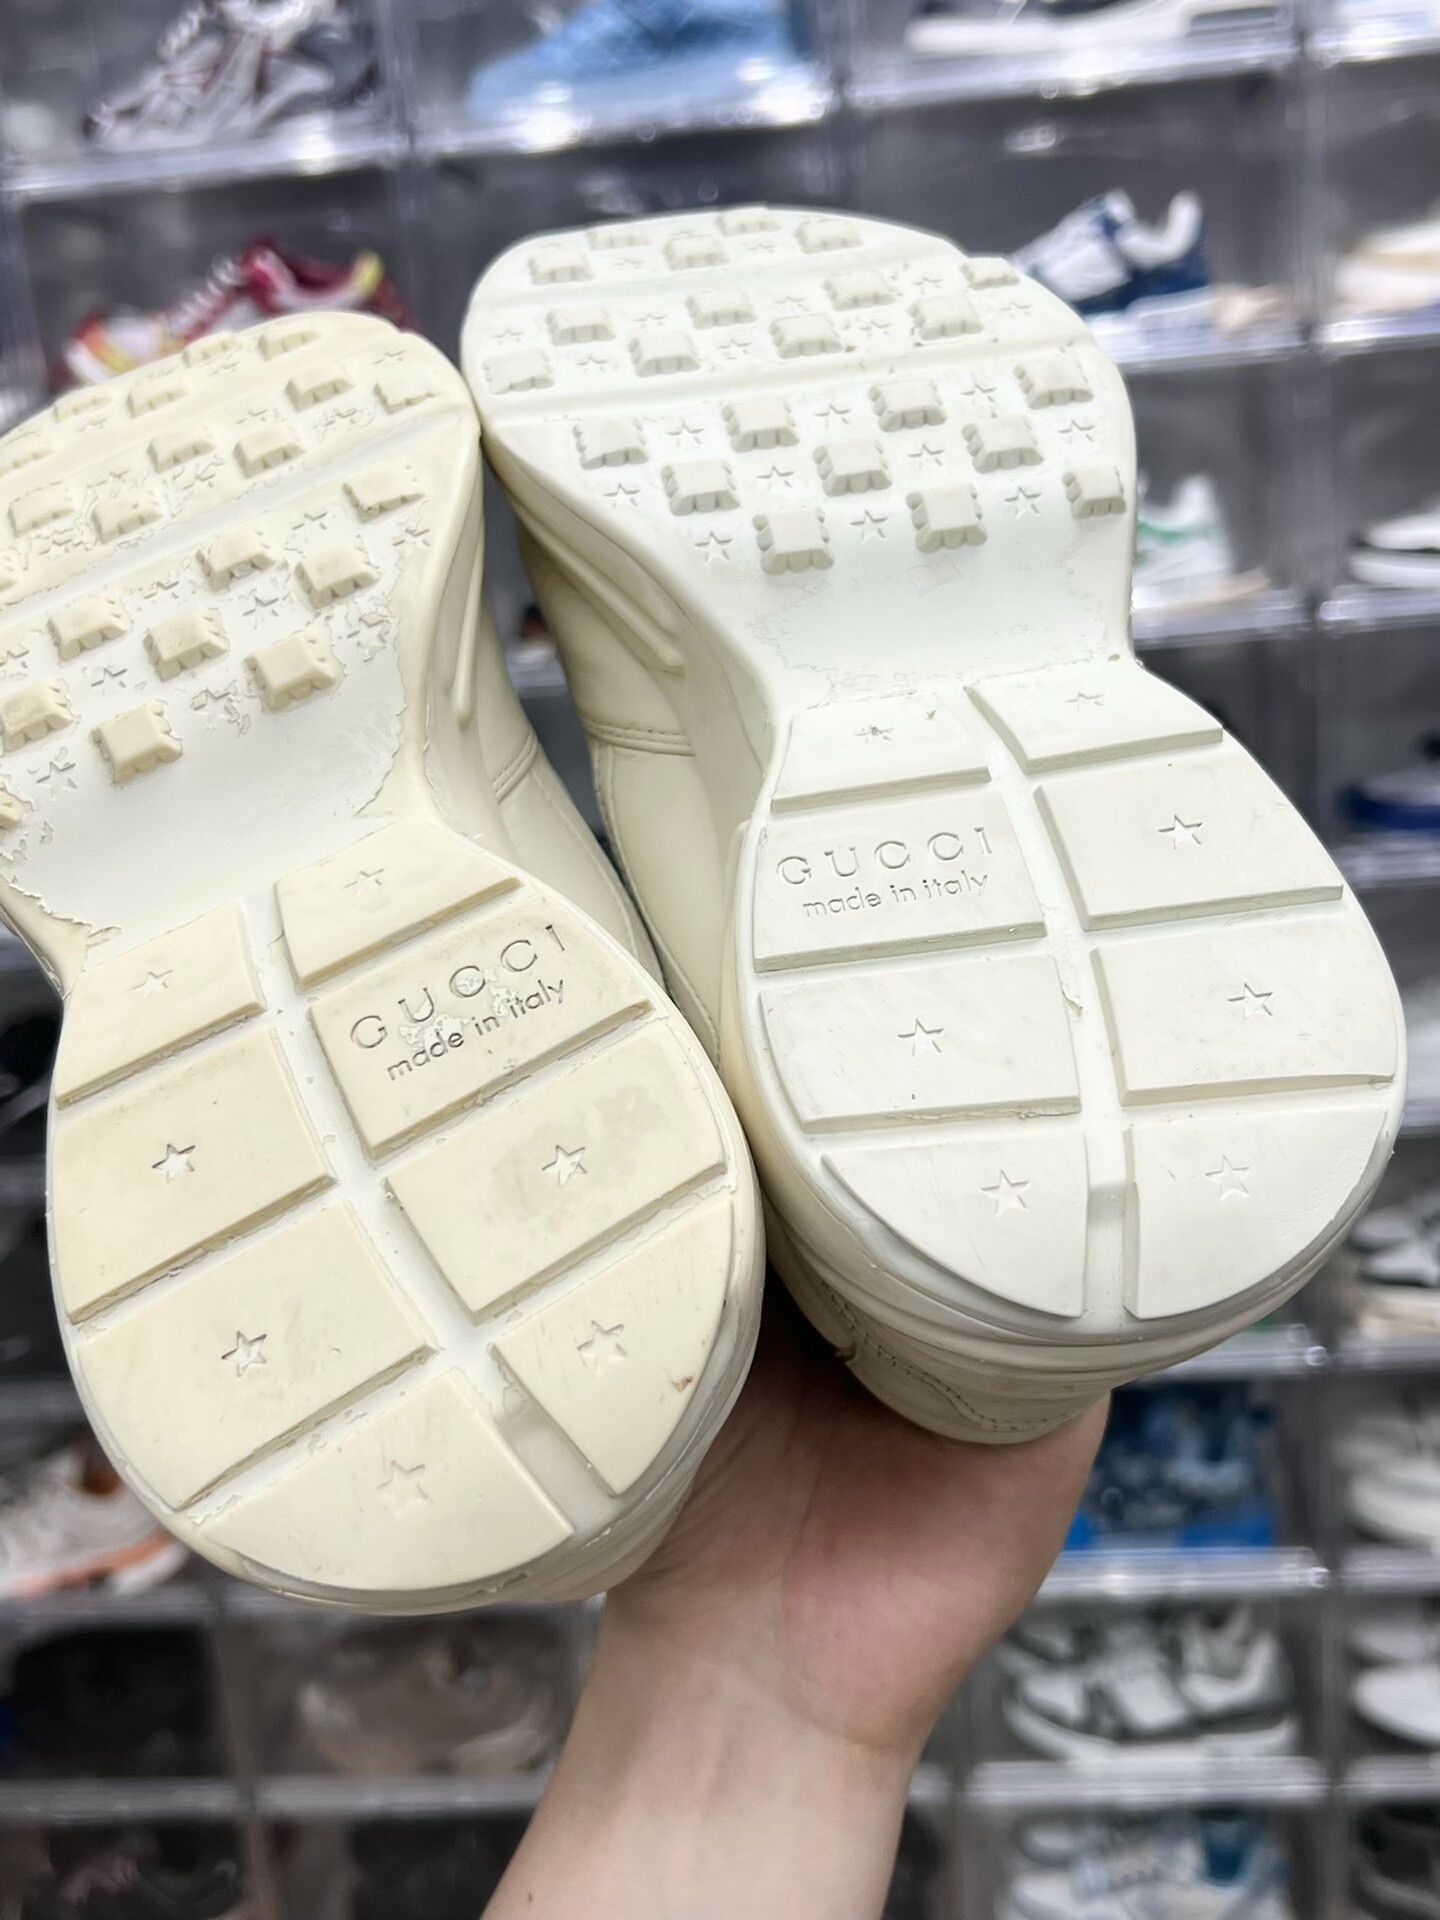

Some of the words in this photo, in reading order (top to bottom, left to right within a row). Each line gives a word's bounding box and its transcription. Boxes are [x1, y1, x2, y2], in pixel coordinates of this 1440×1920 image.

[775, 826, 993, 885] GUCCI
[803, 887, 882, 918] made
[890, 884, 917, 904] in
[922, 869, 989, 898] italy
[350, 924, 566, 1049] GUCCI
[387, 1030, 465, 1081] made
[471, 1015, 501, 1037] in
[506, 979, 565, 1019] italy
